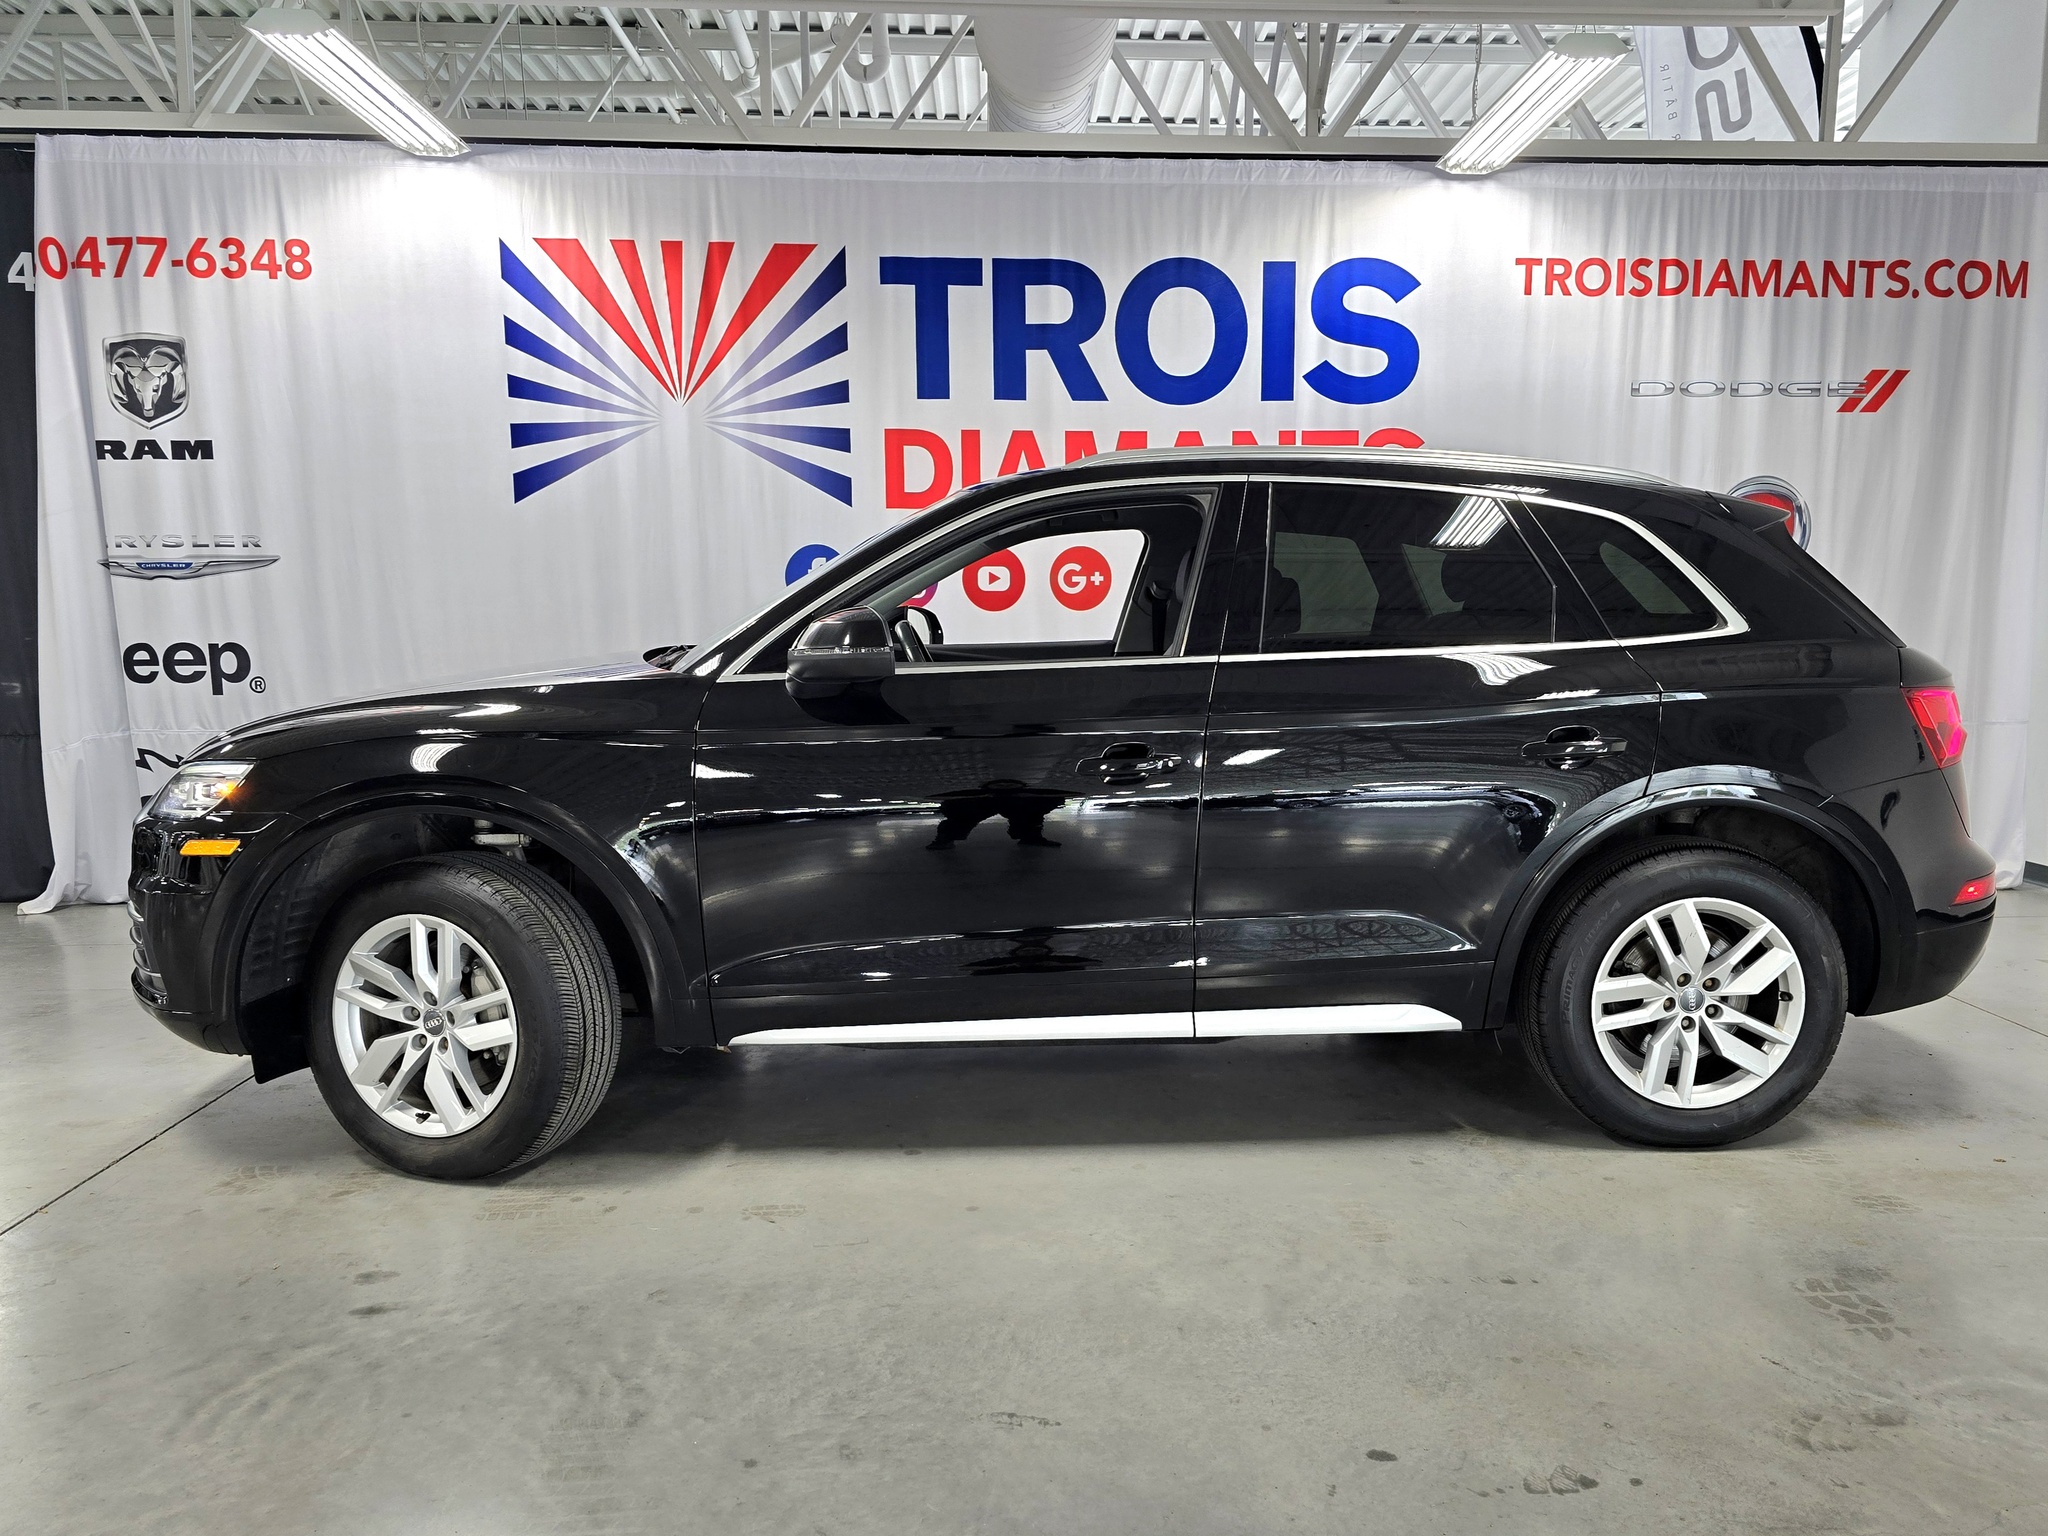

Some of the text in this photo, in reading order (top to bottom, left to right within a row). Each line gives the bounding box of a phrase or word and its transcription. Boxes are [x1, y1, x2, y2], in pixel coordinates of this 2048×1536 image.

[1515, 257, 2029, 299] TROISDIAMANTS.COM
[879, 256, 1422, 405] TROIS
[1630, 379, 1869, 398] DODGE
[95, 439, 214, 461] RAM
